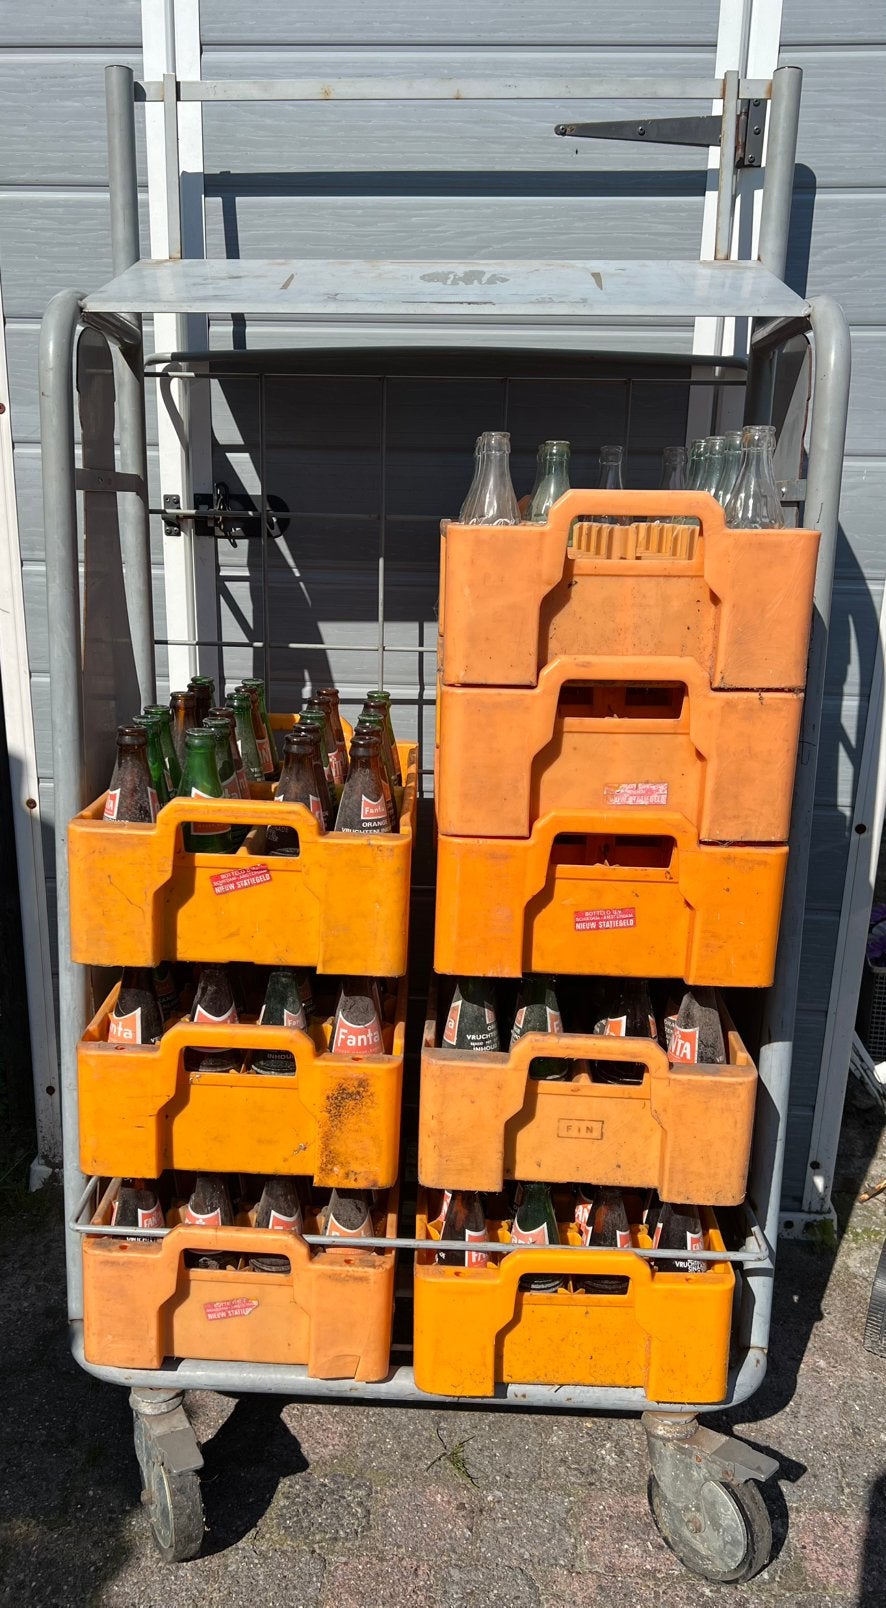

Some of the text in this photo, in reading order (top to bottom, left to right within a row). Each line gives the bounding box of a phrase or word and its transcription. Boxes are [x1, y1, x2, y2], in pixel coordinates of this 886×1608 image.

[215, 873, 271, 894] NIEUW STATIEGELD
[575, 919, 634, 930] NIEUW STATIEGELD
[109, 1021, 133, 1039] nta
[337, 1028, 380, 1047] Fanta
[671, 1033, 691, 1061] NTA
[566, 1125, 594, 1135] FIN
